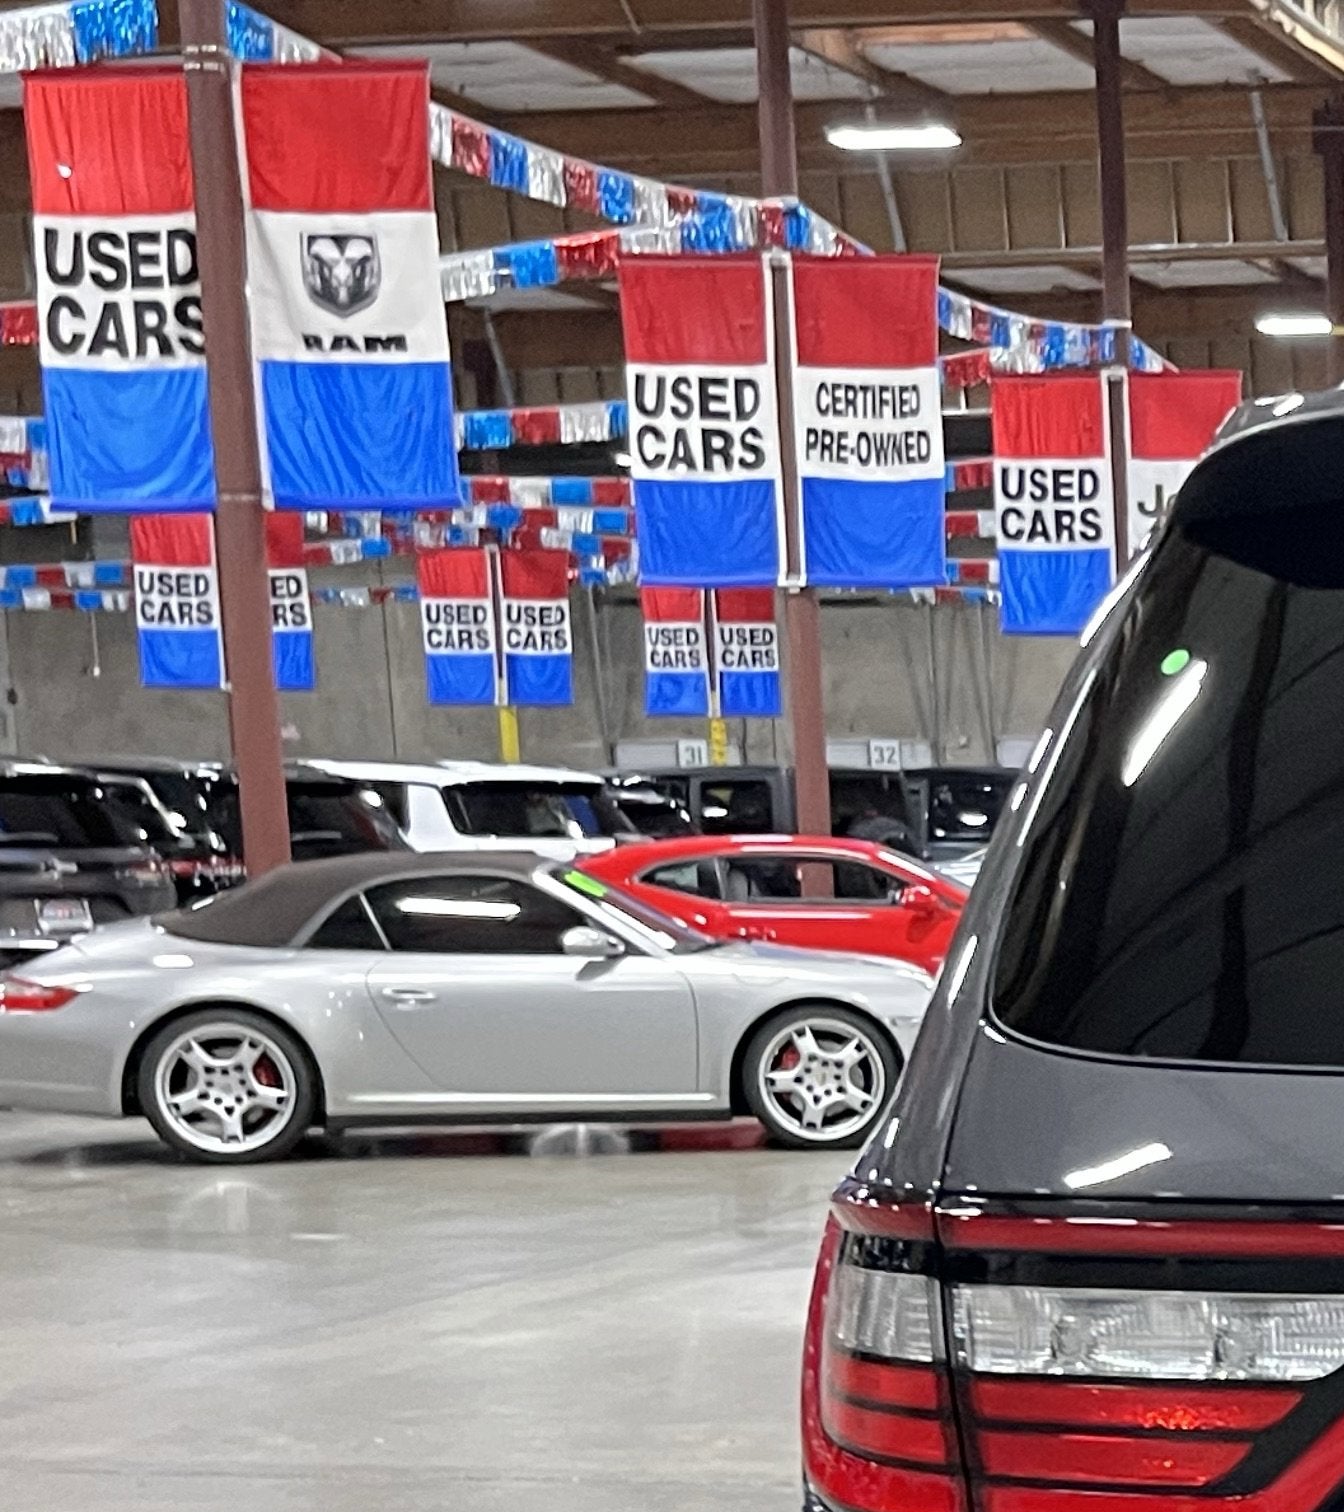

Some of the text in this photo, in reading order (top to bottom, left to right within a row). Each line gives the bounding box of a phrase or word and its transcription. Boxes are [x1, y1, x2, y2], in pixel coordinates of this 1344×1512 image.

[44, 228, 199, 291] USED
[47, 295, 206, 357] CARS
[301, 332, 408, 353] RAM
[635, 374, 761, 422] USED
[816, 382, 921, 420] CERTIFIED
[636, 425, 766, 472] CARS
[805, 427, 931, 467] PRE-OWNED
[1001, 467, 1099, 502] USED
[1001, 507, 1102, 542] CARS
[138, 571, 209, 597] USED
[270, 575, 303, 599] ED
[140, 600, 214, 626] CARS
[272, 602, 307, 627] RS
[425, 604, 487, 625] USED
[506, 604, 565, 626] USED
[427, 628, 490, 649] CARS
[507, 628, 567, 650] CARS
[647, 627, 699, 647] USED
[720, 627, 774, 647] USED
[650, 649, 701, 668] CARS
[721, 650, 776, 668] CARS
[874, 745, 896, 764] 32
